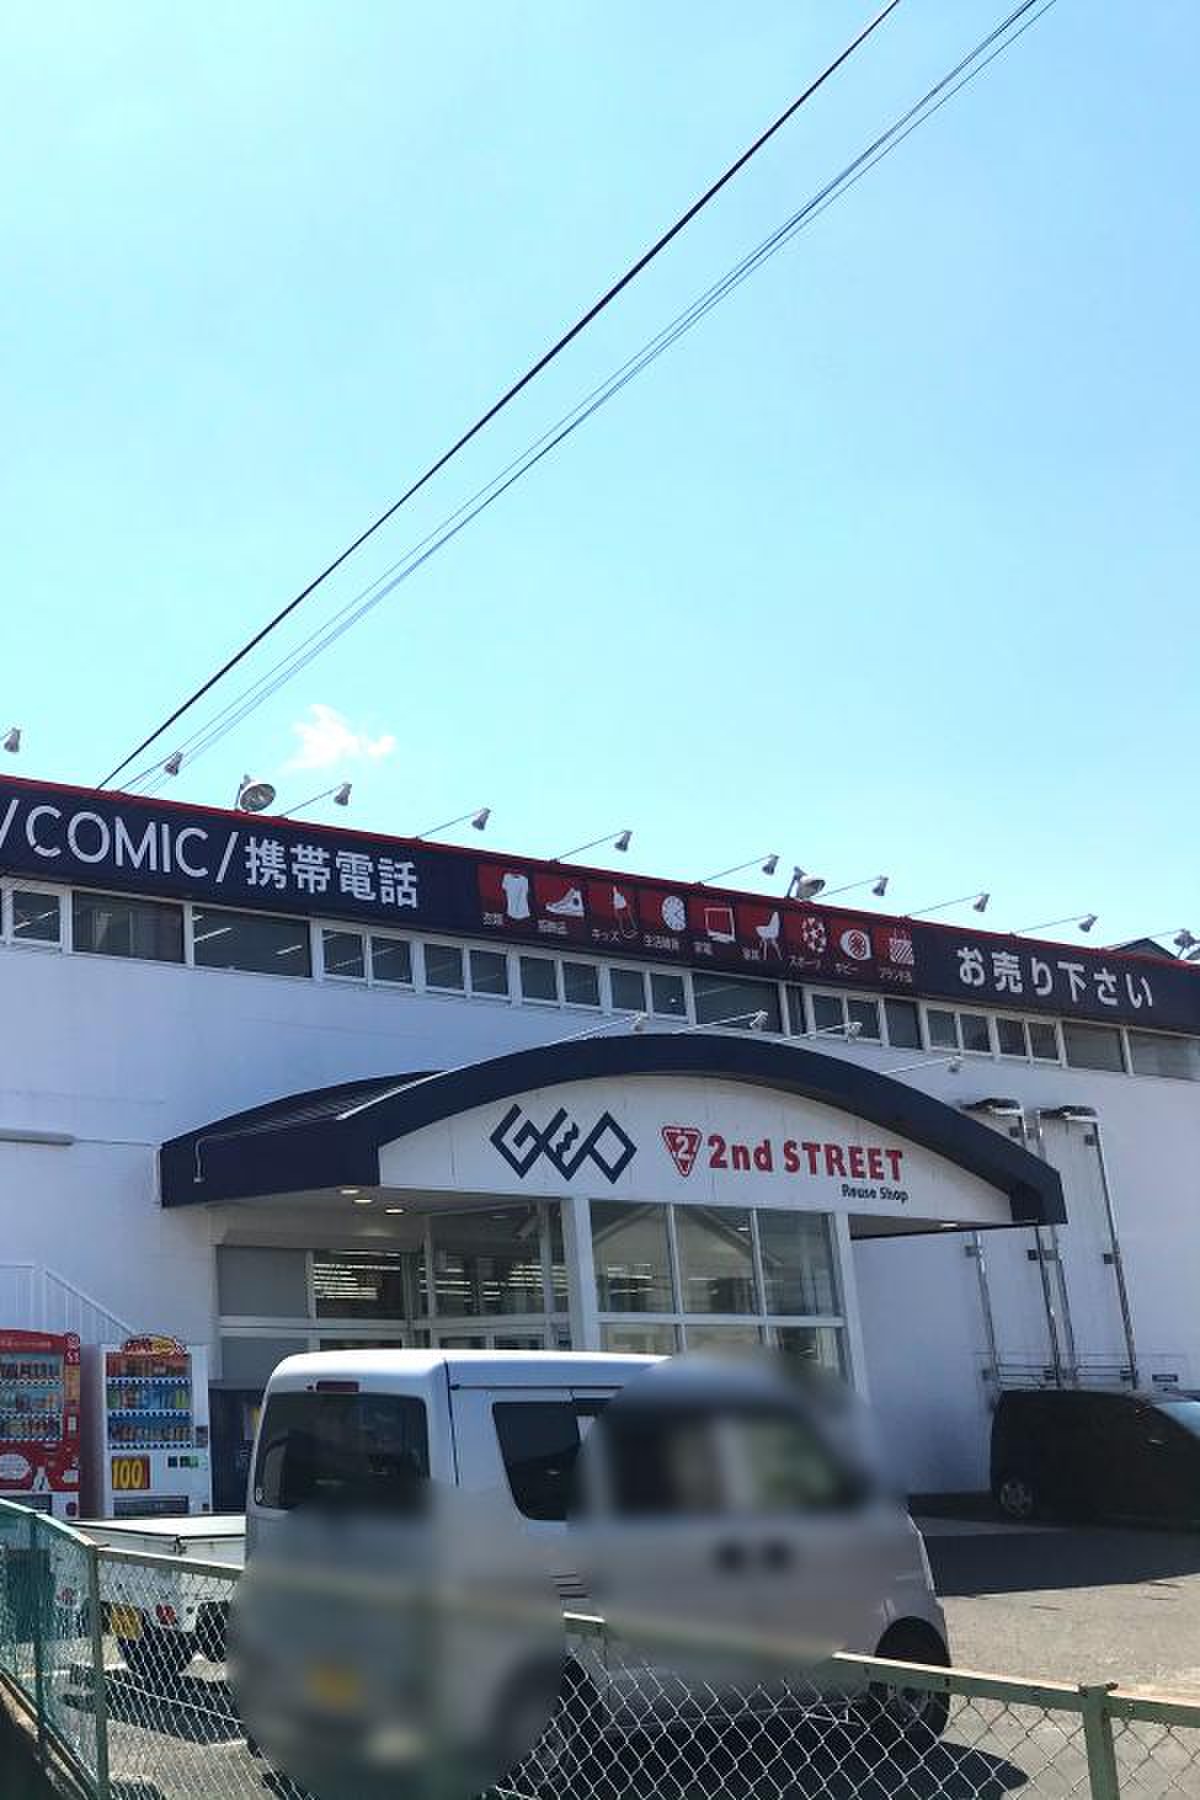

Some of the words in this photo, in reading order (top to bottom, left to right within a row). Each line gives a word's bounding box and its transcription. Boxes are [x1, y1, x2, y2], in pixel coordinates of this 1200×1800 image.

[957, 946, 1153, 1009] お売り下さい
[707, 1134, 774, 1172] 2nd
[783, 1139, 904, 1182] STREET
[841, 1183, 877, 1200] Reuse
[879, 1186, 910, 1204] Shop
[112, 1460, 144, 1489] 100
